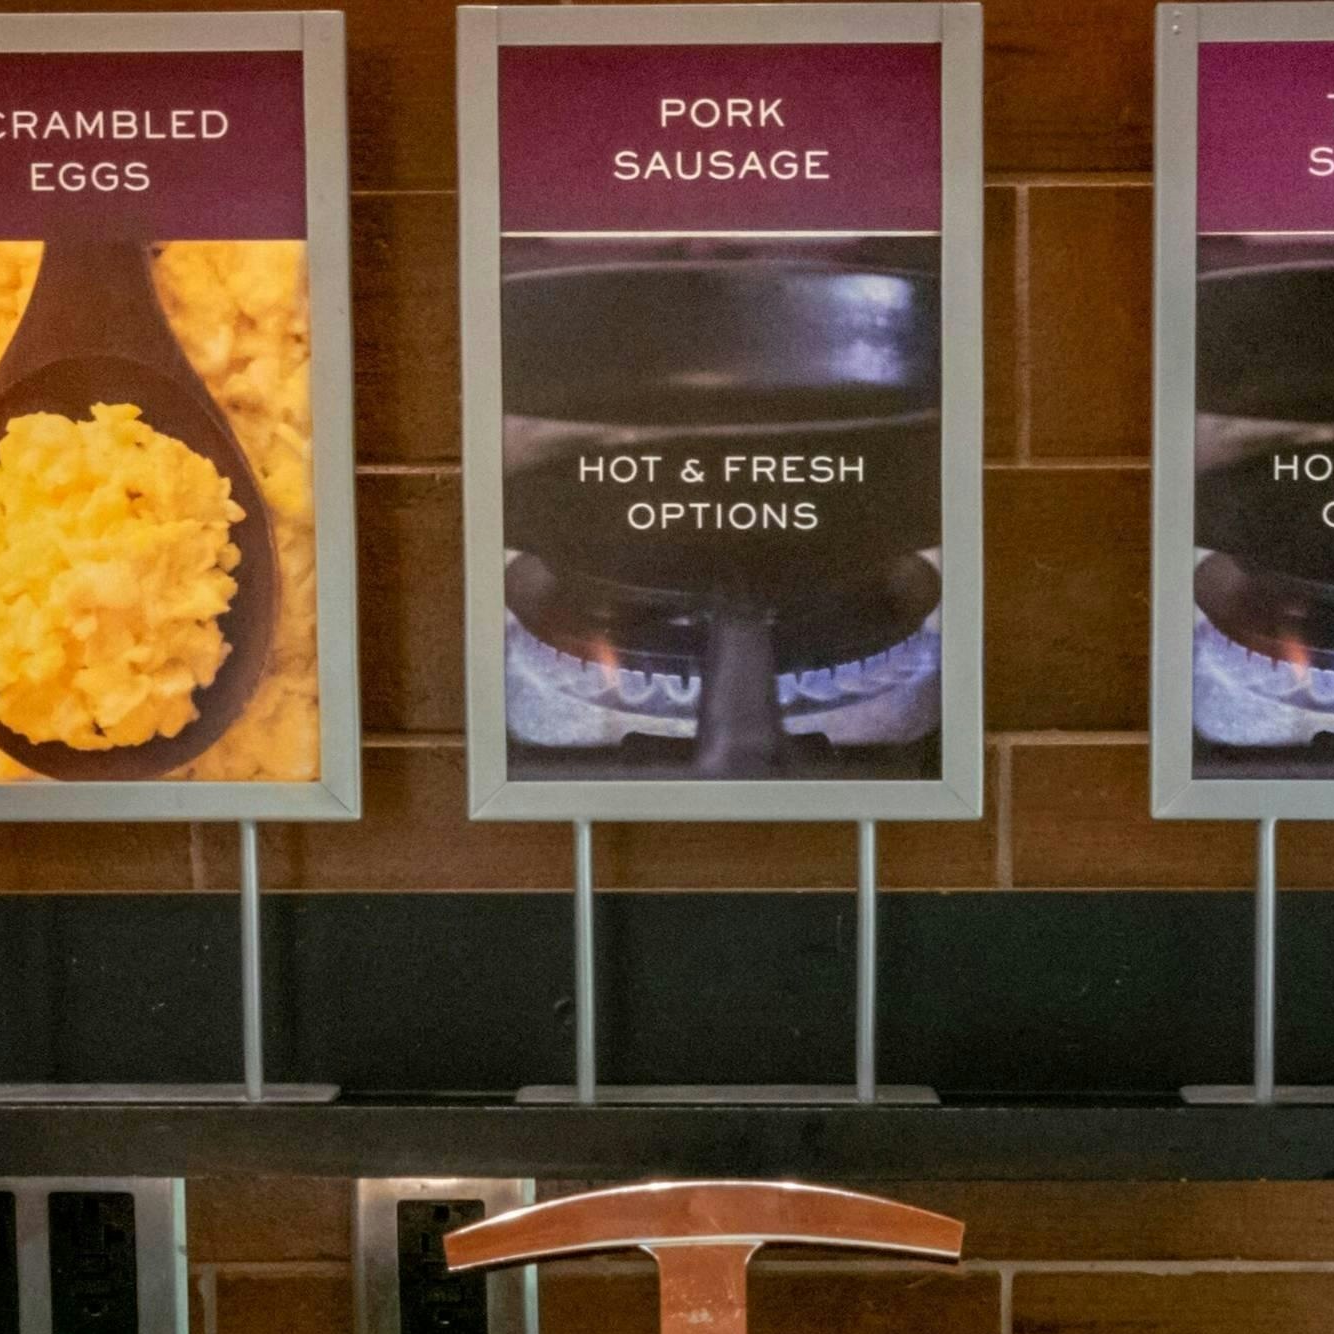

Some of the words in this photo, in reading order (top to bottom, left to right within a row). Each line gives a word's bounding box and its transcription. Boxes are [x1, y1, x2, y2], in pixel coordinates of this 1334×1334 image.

[659, 98, 786, 129] PORK
[29, 162, 151, 192] EGGS
[612, 150, 831, 181] SAUSAGE
[578, 455, 663, 484] HOT
[679, 458, 705, 484] &
[724, 455, 865, 484] FRESH
[626, 501, 820, 531] OPTIONS
